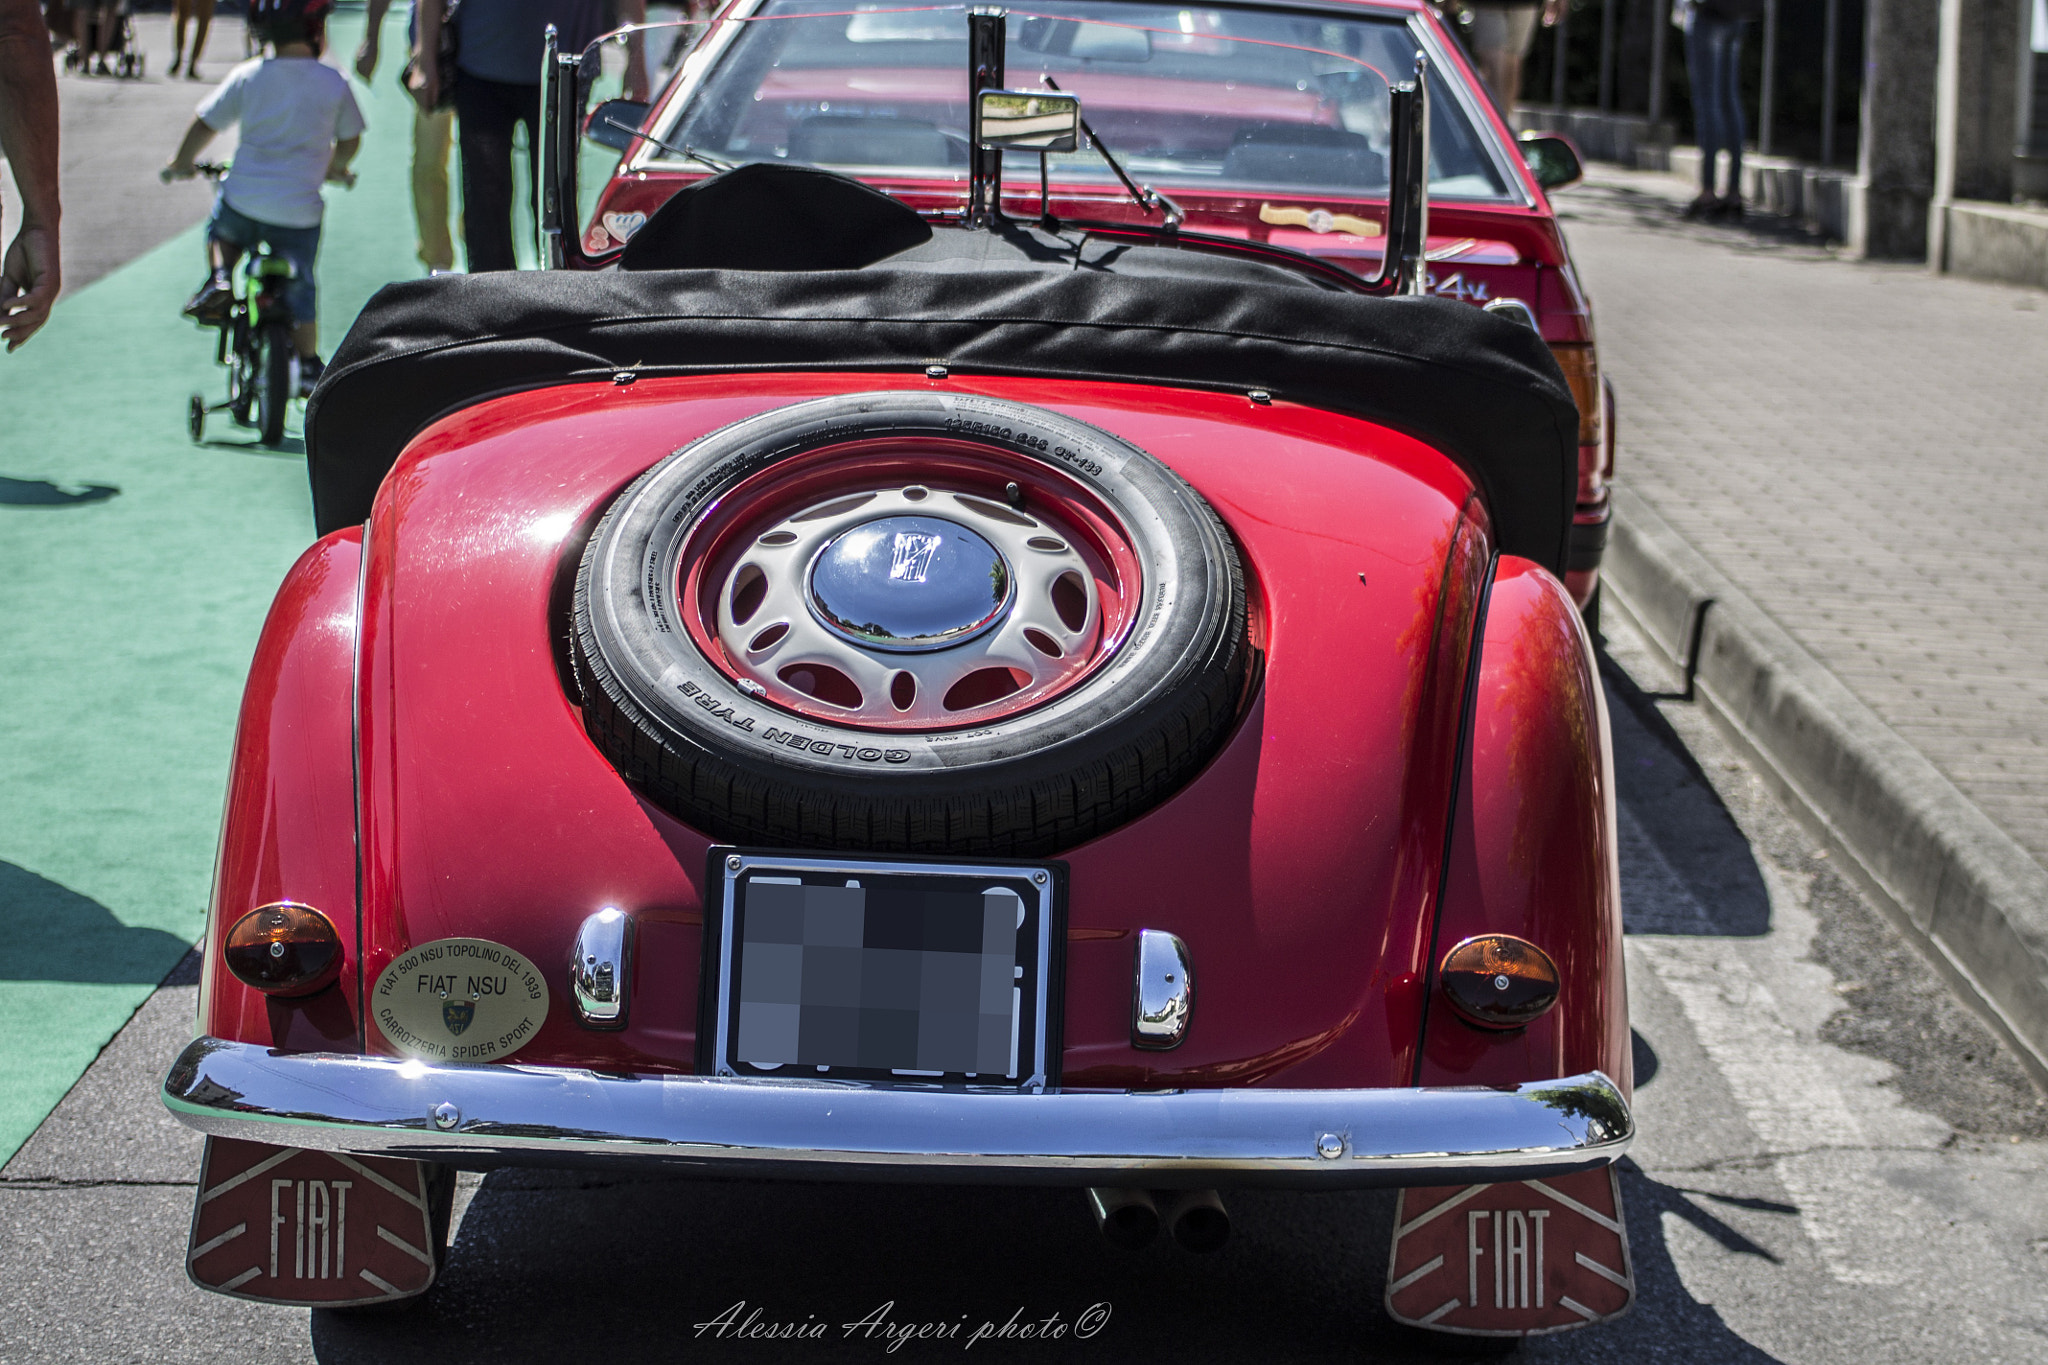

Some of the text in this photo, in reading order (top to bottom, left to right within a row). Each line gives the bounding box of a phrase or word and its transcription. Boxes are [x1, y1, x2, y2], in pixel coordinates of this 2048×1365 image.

[676, 680, 912, 764] GOLDEN TYRE
[380, 944, 542, 1000] FIAT 500 NSU TOPOLINO DEL 1939
[417, 975, 508, 995] FIAT NSU
[380, 1008, 535, 1059] CARROZZERIA SPIDER SPORT
[270, 1179, 353, 1279] FIAT
[1468, 1210, 1550, 1309] FIAT
